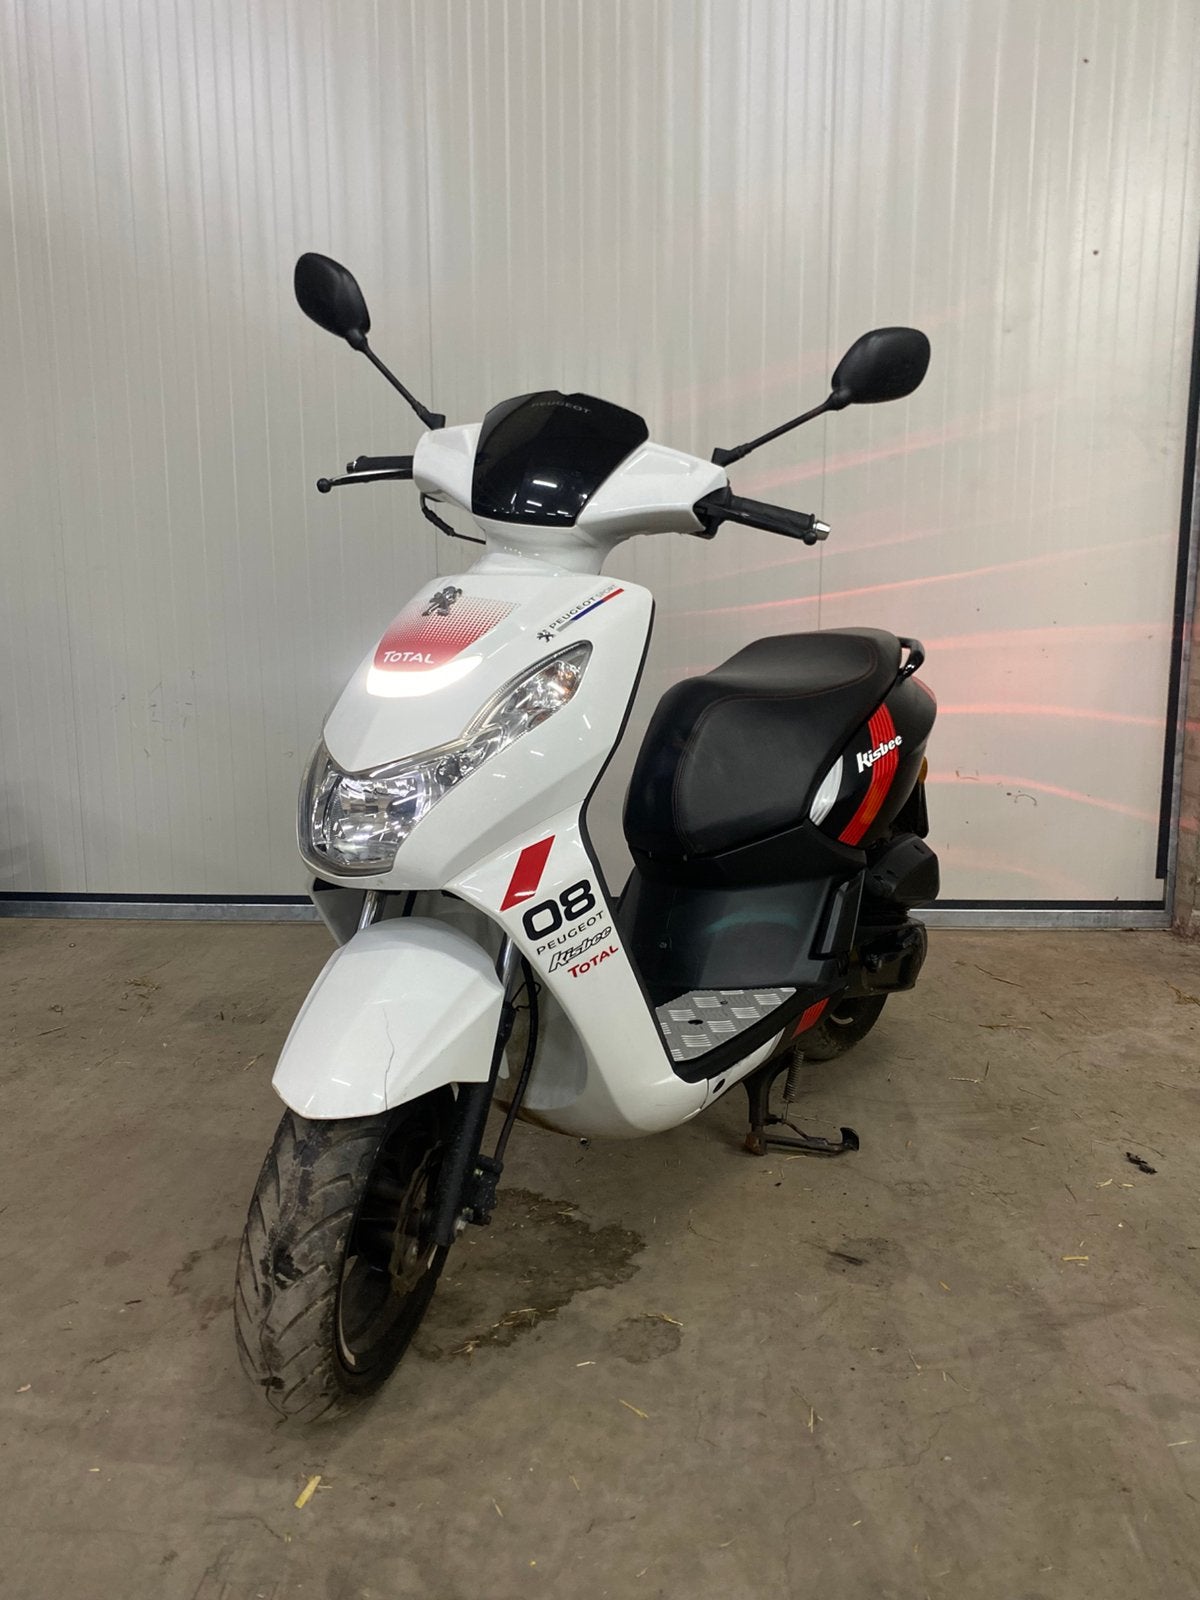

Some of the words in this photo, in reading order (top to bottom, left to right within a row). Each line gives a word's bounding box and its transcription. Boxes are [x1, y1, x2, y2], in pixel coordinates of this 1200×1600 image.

[549, 596, 597, 629] PEUGEOT
[595, 584, 617, 598] SPORT
[383, 650, 435, 665] TOTAL
[856, 735, 903, 774] Kisbee
[522, 879, 596, 941] 08
[536, 910, 604, 955] PEUGEOT
[548, 926, 612, 973] Kisbee
[567, 945, 619, 978] TOTAL
